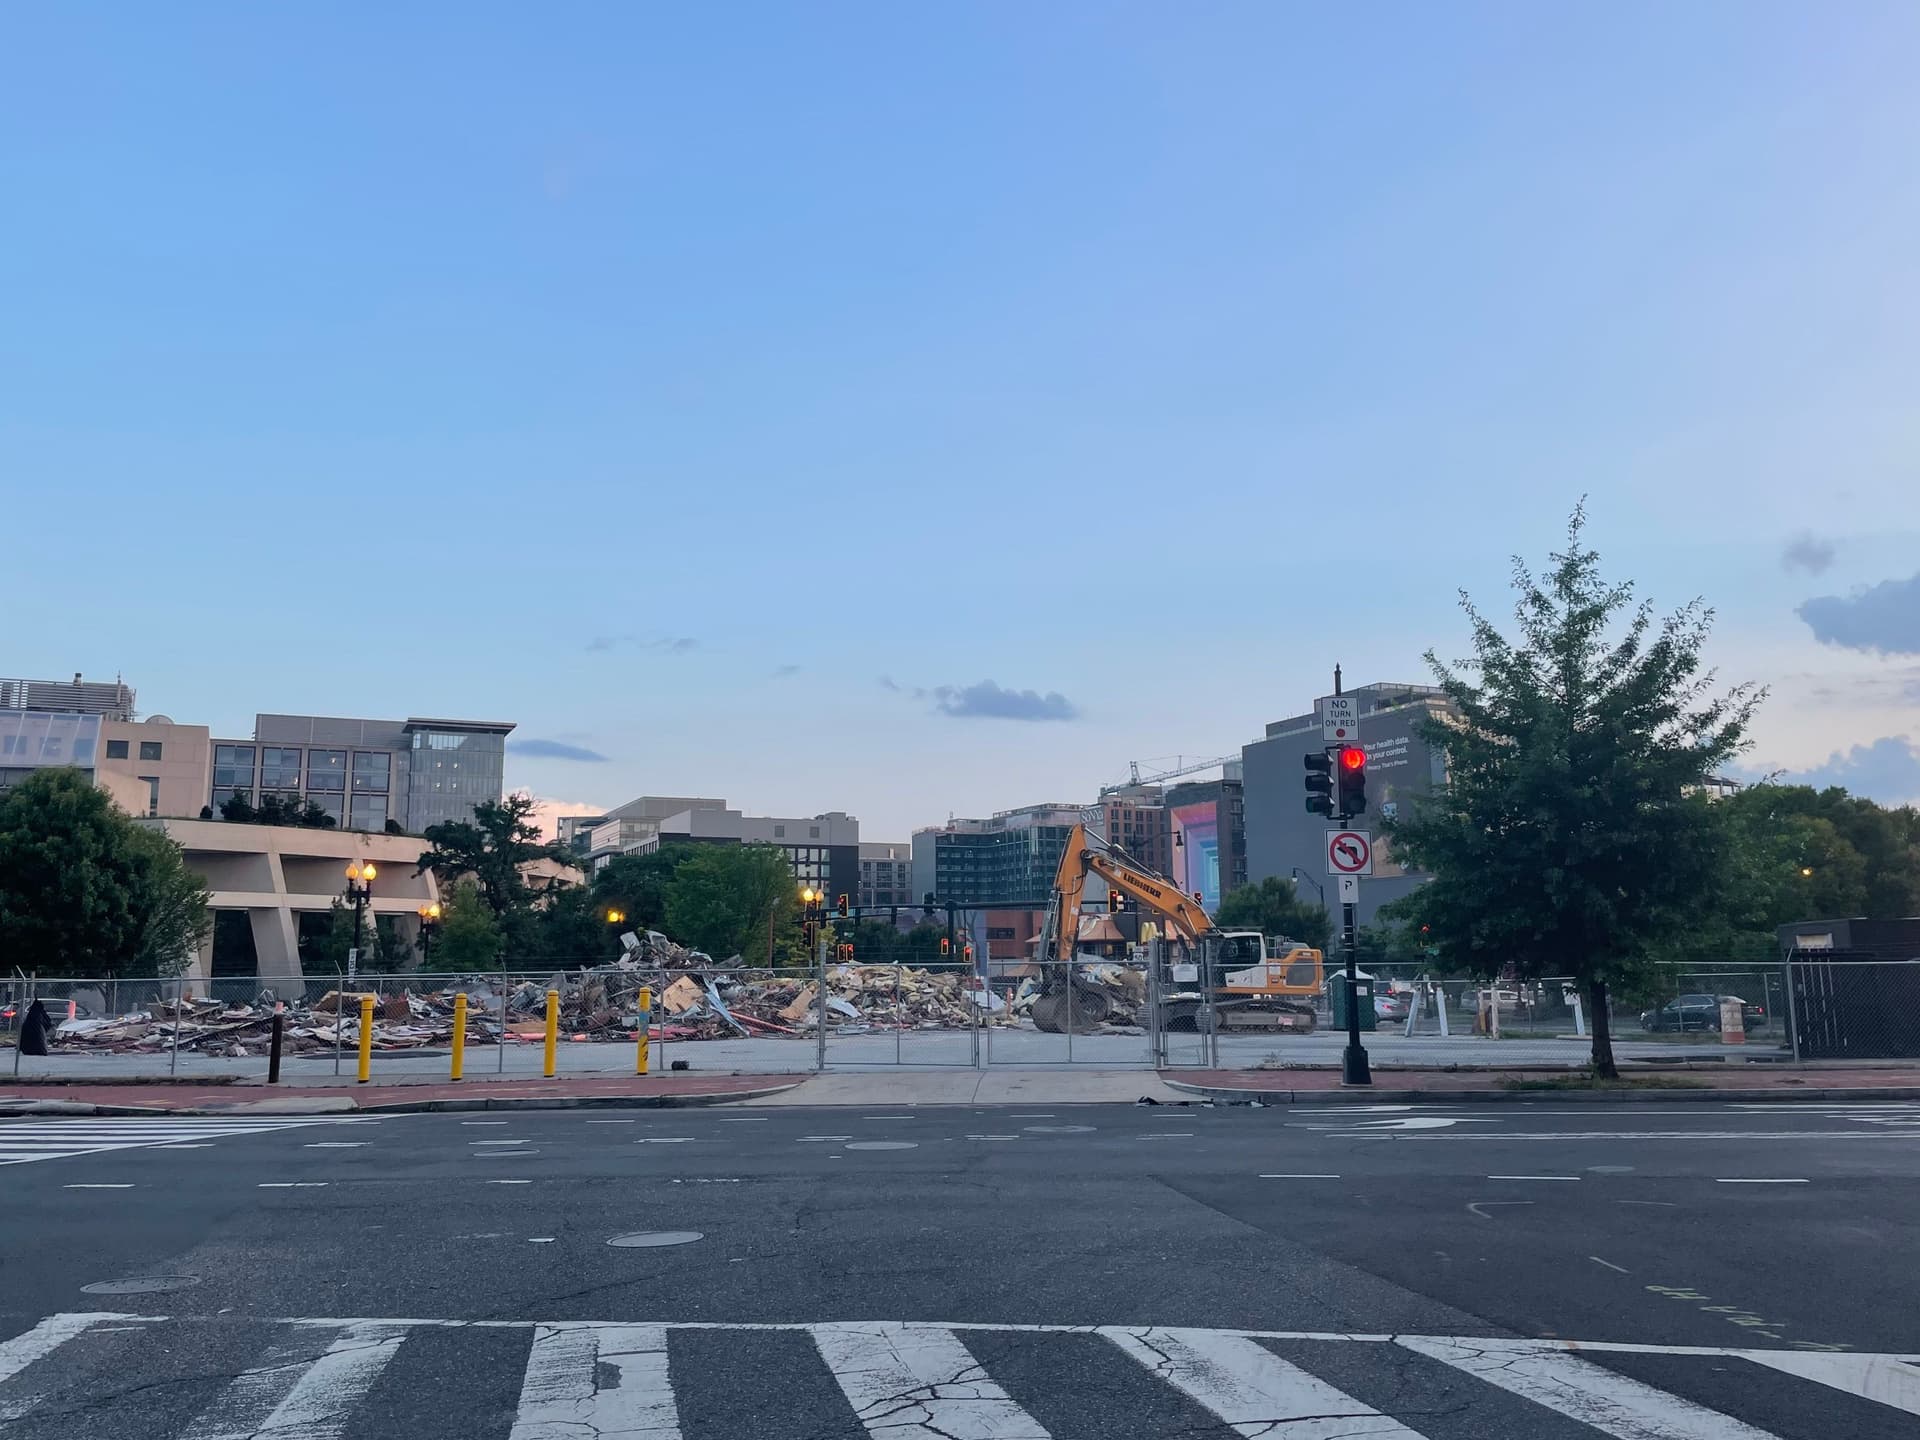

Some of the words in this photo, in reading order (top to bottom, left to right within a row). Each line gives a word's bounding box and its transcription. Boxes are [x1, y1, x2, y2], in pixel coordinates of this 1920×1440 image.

[1332, 700, 1347, 708] NO
[1330, 710, 1351, 718] TURN
[1325, 719, 1336, 727] ON
[1340, 719, 1356, 727] RED
[1377, 739, 1394, 748] health
[1373, 751, 1385, 760] your
[1124, 873, 1161, 898] LIEBHERR
